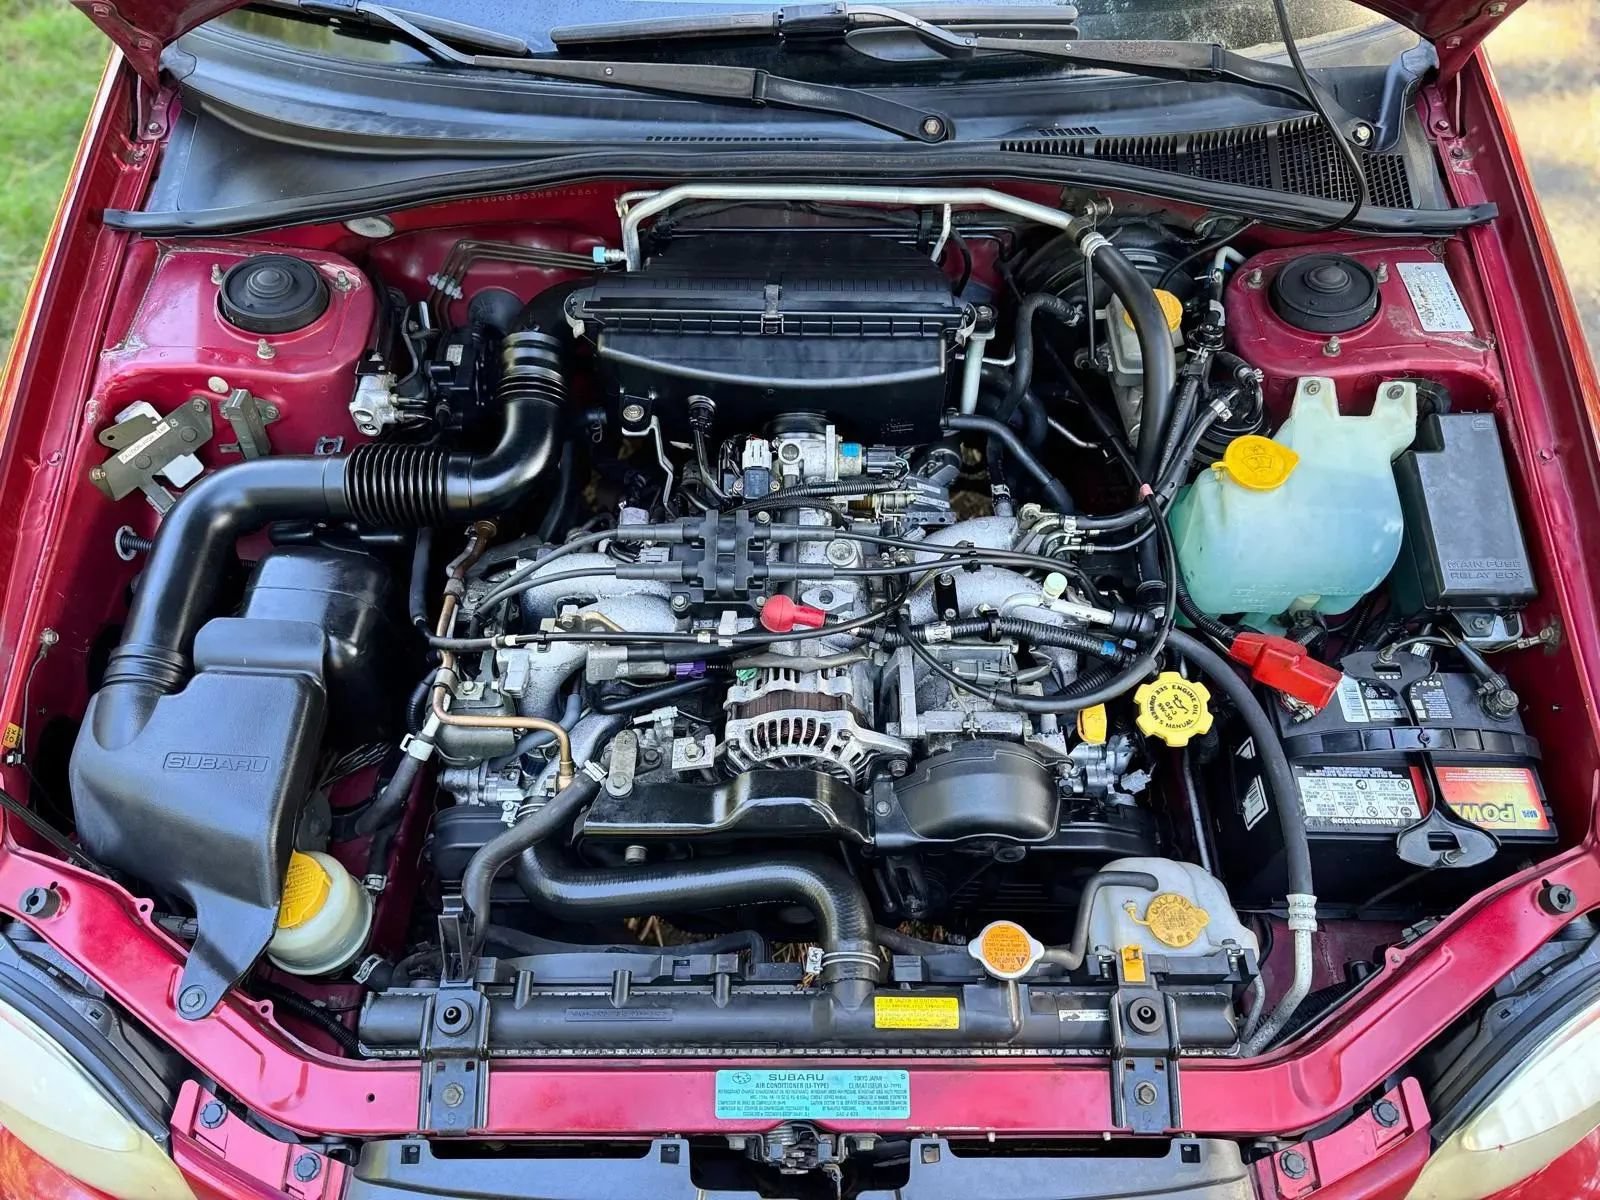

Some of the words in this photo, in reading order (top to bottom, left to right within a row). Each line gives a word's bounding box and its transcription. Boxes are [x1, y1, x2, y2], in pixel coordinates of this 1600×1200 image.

[1447, 560, 1482, 568] MAIN
[1486, 559, 1521, 568] FUSE
[1172, 684, 1197, 704] ENGINE
[1165, 718, 1194, 729] MANUAL
[167, 755, 269, 773] SUBARU
[768, 1073, 825, 1081] SUBARU
